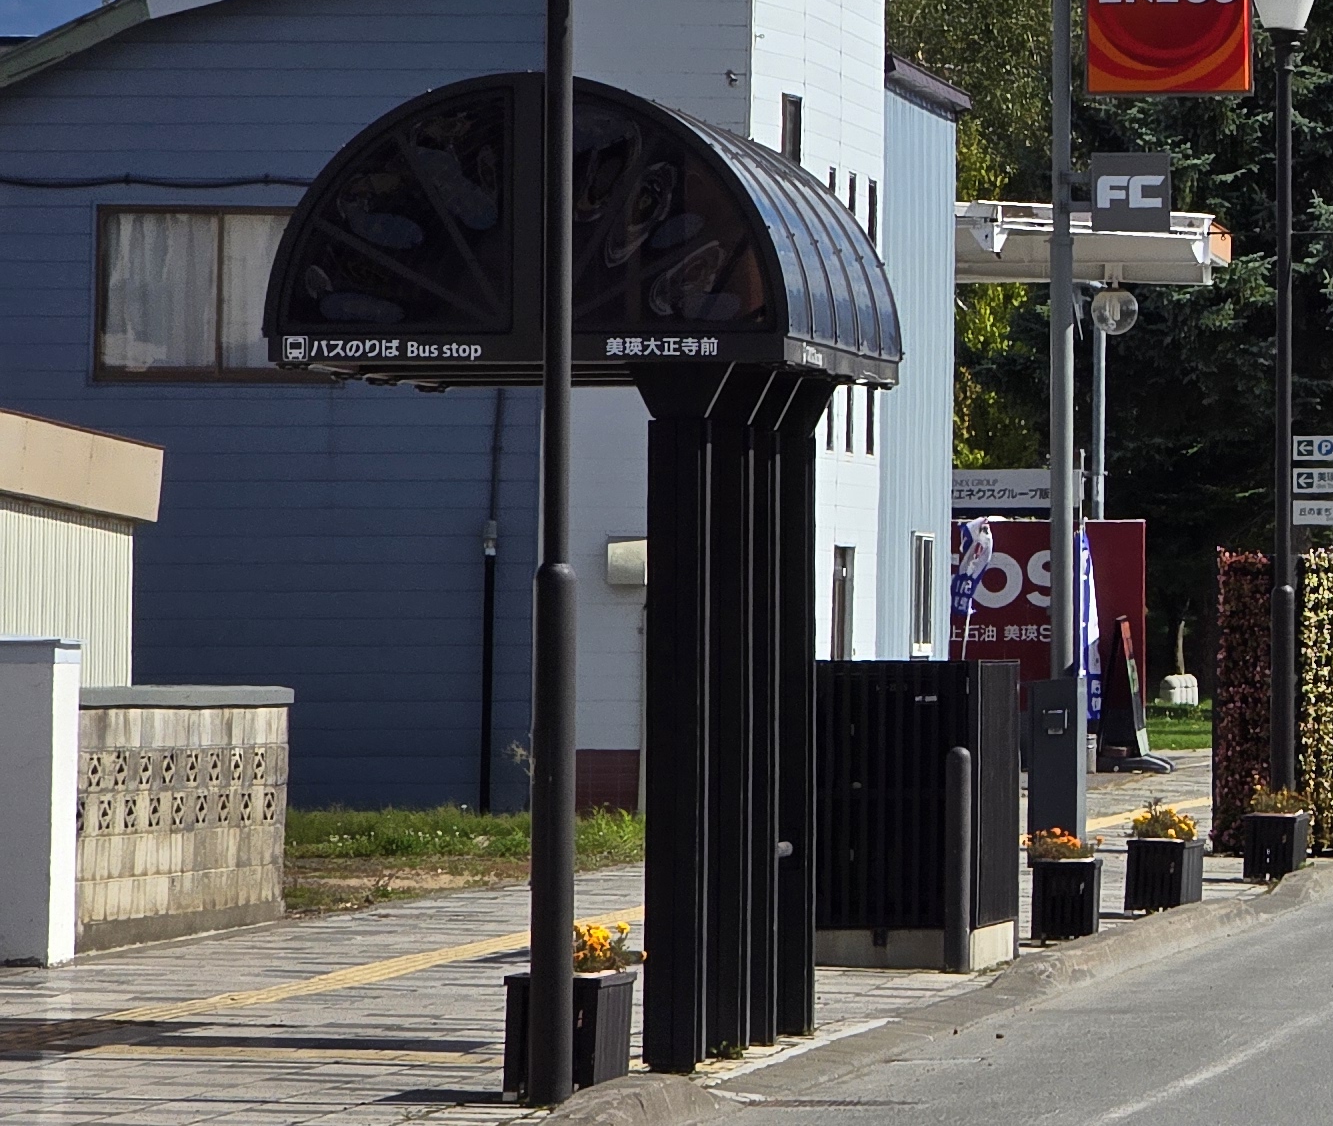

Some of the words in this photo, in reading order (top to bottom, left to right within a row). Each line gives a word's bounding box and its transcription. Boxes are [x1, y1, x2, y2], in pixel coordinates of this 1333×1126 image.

[1096, 175, 1166, 209] FC
[310, 339, 400, 357] バスのりば
[407, 341, 439, 357] Bus
[442, 341, 482, 360] stop
[605, 337, 719, 356] 美瑛大正寺前
